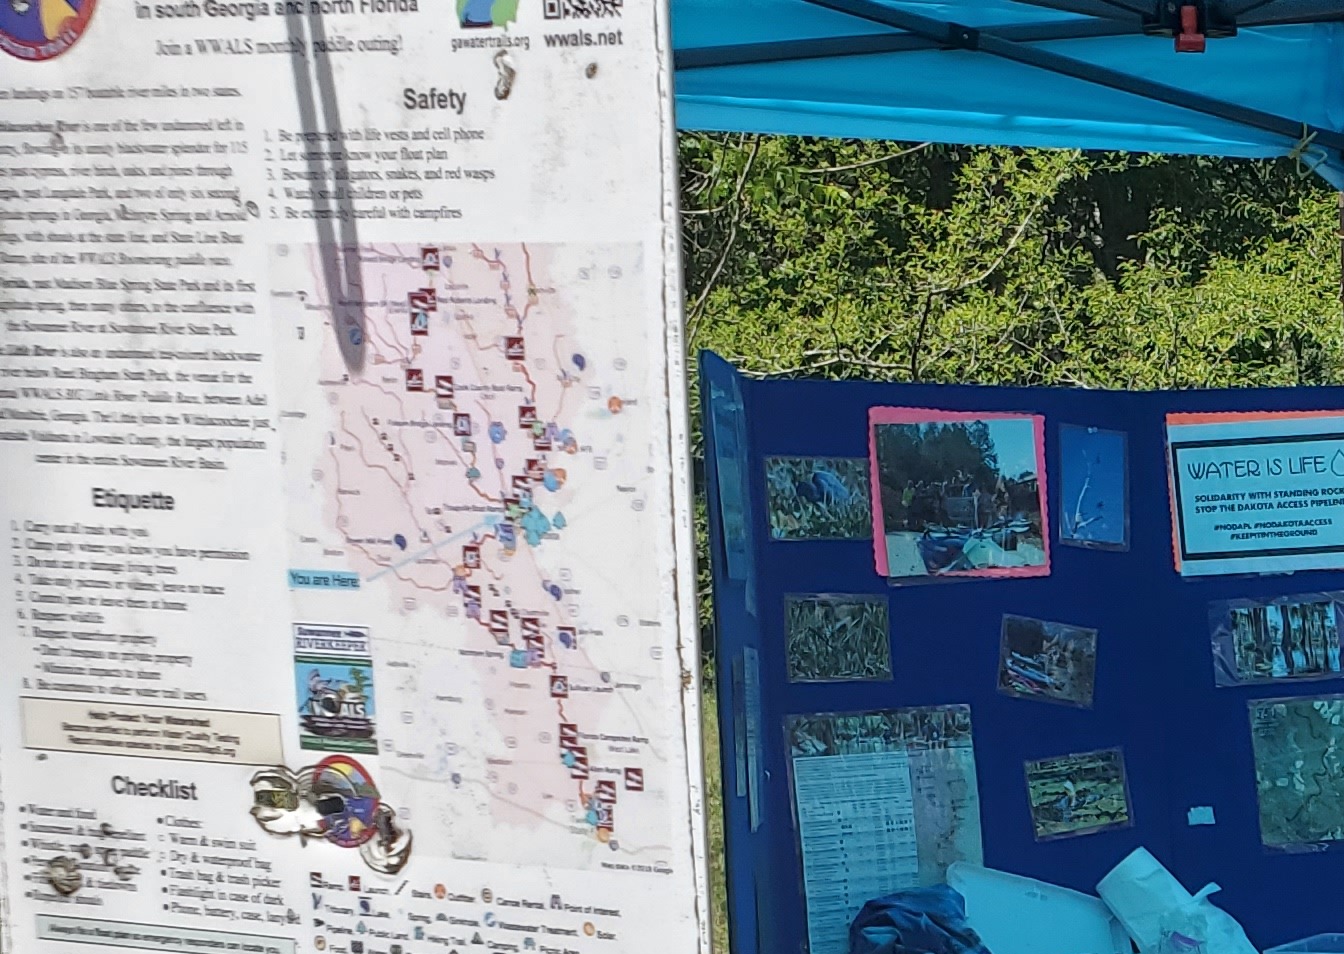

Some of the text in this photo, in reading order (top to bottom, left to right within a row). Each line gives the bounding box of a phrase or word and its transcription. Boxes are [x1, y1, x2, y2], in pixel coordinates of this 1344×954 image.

[204, 0, 270, 20] Georgia
[451, 35, 529, 52] gawatertrails.org
[544, 29, 623, 47] wwals.net
[403, 87, 466, 114] Safety
[1187, 456, 1327, 480] WATER IS LIFE
[1194, 493, 1246, 504] SOLIDARITY
[1248, 490, 1272, 501] WITH
[1274, 488, 1320, 500] STANDING
[1195, 505, 1217, 514] STOP
[1220, 503, 1236, 513] THE
[1237, 501, 1275, 512] DAKOTA
[1277, 499, 1309, 510] ACCESS
[289, 571, 312, 586] You
[313, 574, 333, 586] are
[111, 775, 199, 801] Checklist
